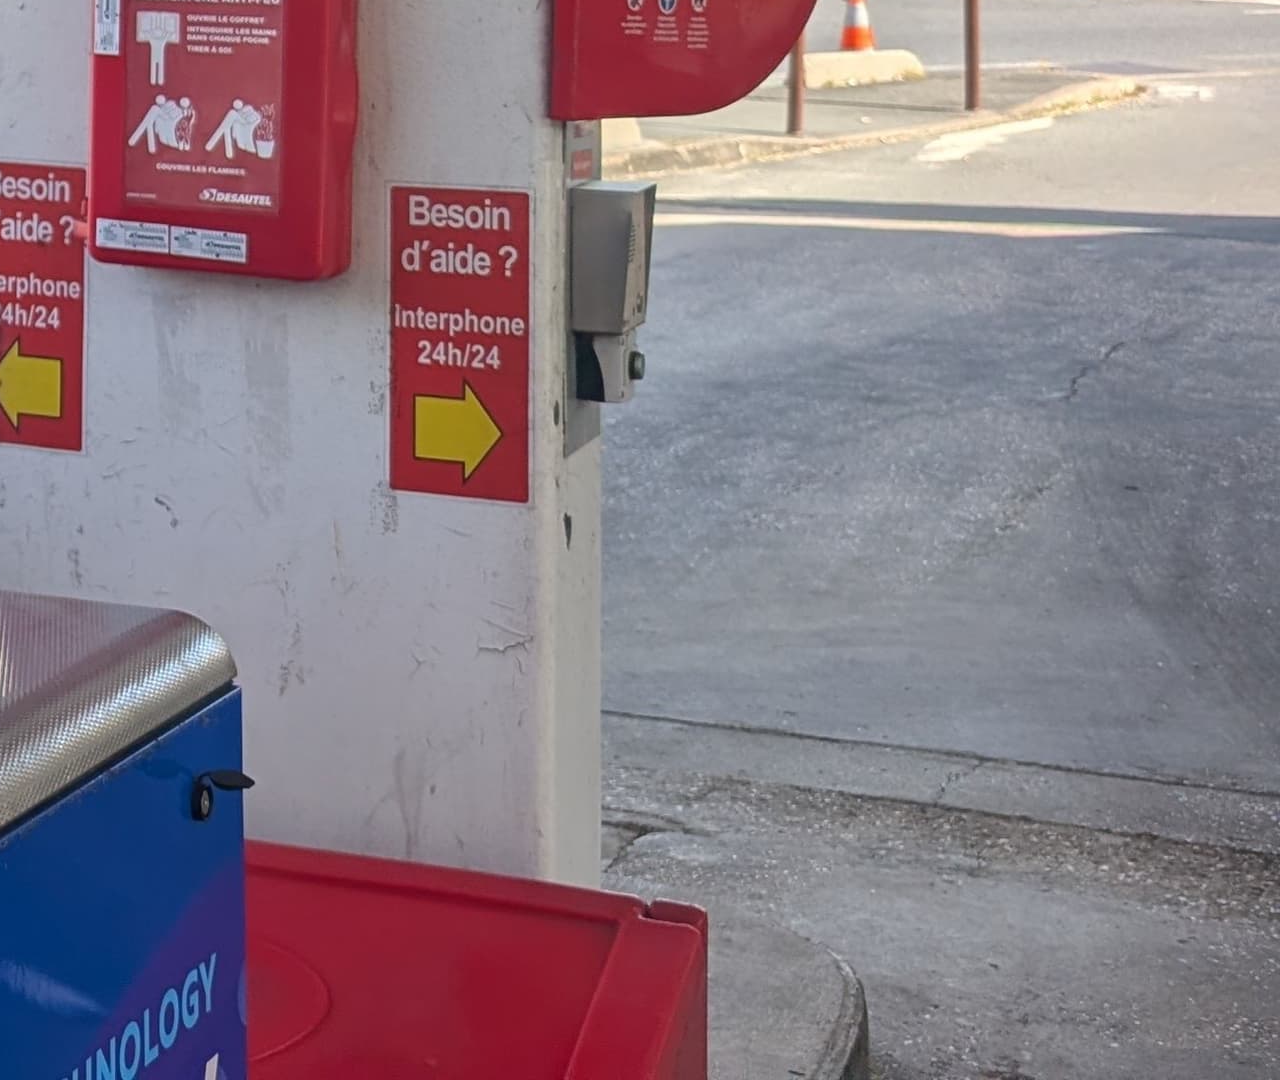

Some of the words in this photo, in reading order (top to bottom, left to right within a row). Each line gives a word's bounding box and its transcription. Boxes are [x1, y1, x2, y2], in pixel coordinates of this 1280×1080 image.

[216, 191, 272, 207] DESAUTEL
[408, 194, 511, 231] Besoin
[59, 215, 76, 245] ?
[401, 240, 492, 276] d'aide
[498, 245, 518, 277] ?
[394, 303, 525, 336] Interphone
[417, 339, 501, 369] 24h/24
